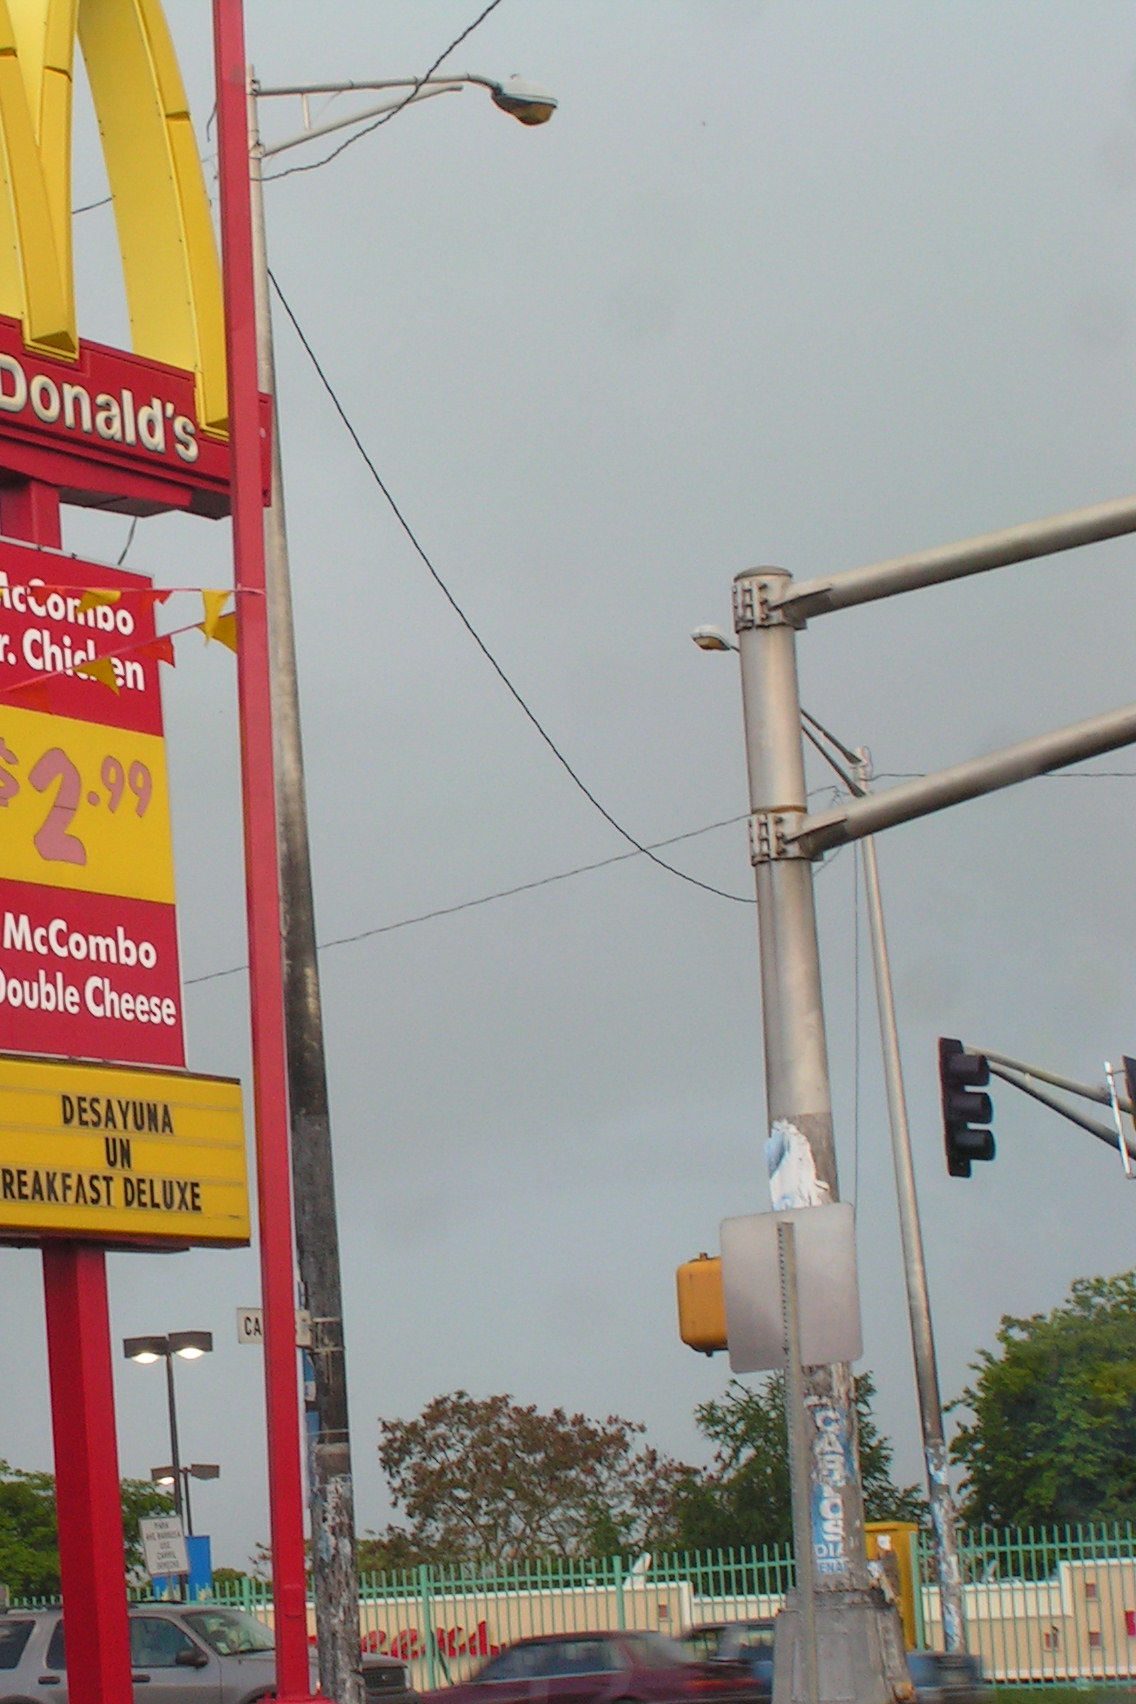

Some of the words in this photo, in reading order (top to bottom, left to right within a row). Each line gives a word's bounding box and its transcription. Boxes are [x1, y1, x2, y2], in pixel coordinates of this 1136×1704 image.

[2, 911, 157, 969] McCombo
[84, 975, 176, 1026] Cheese
[61, 1093, 174, 1134] DESAYUNA
[104, 1137, 131, 1169] UN
[123, 1176, 202, 1212] DELUXE
